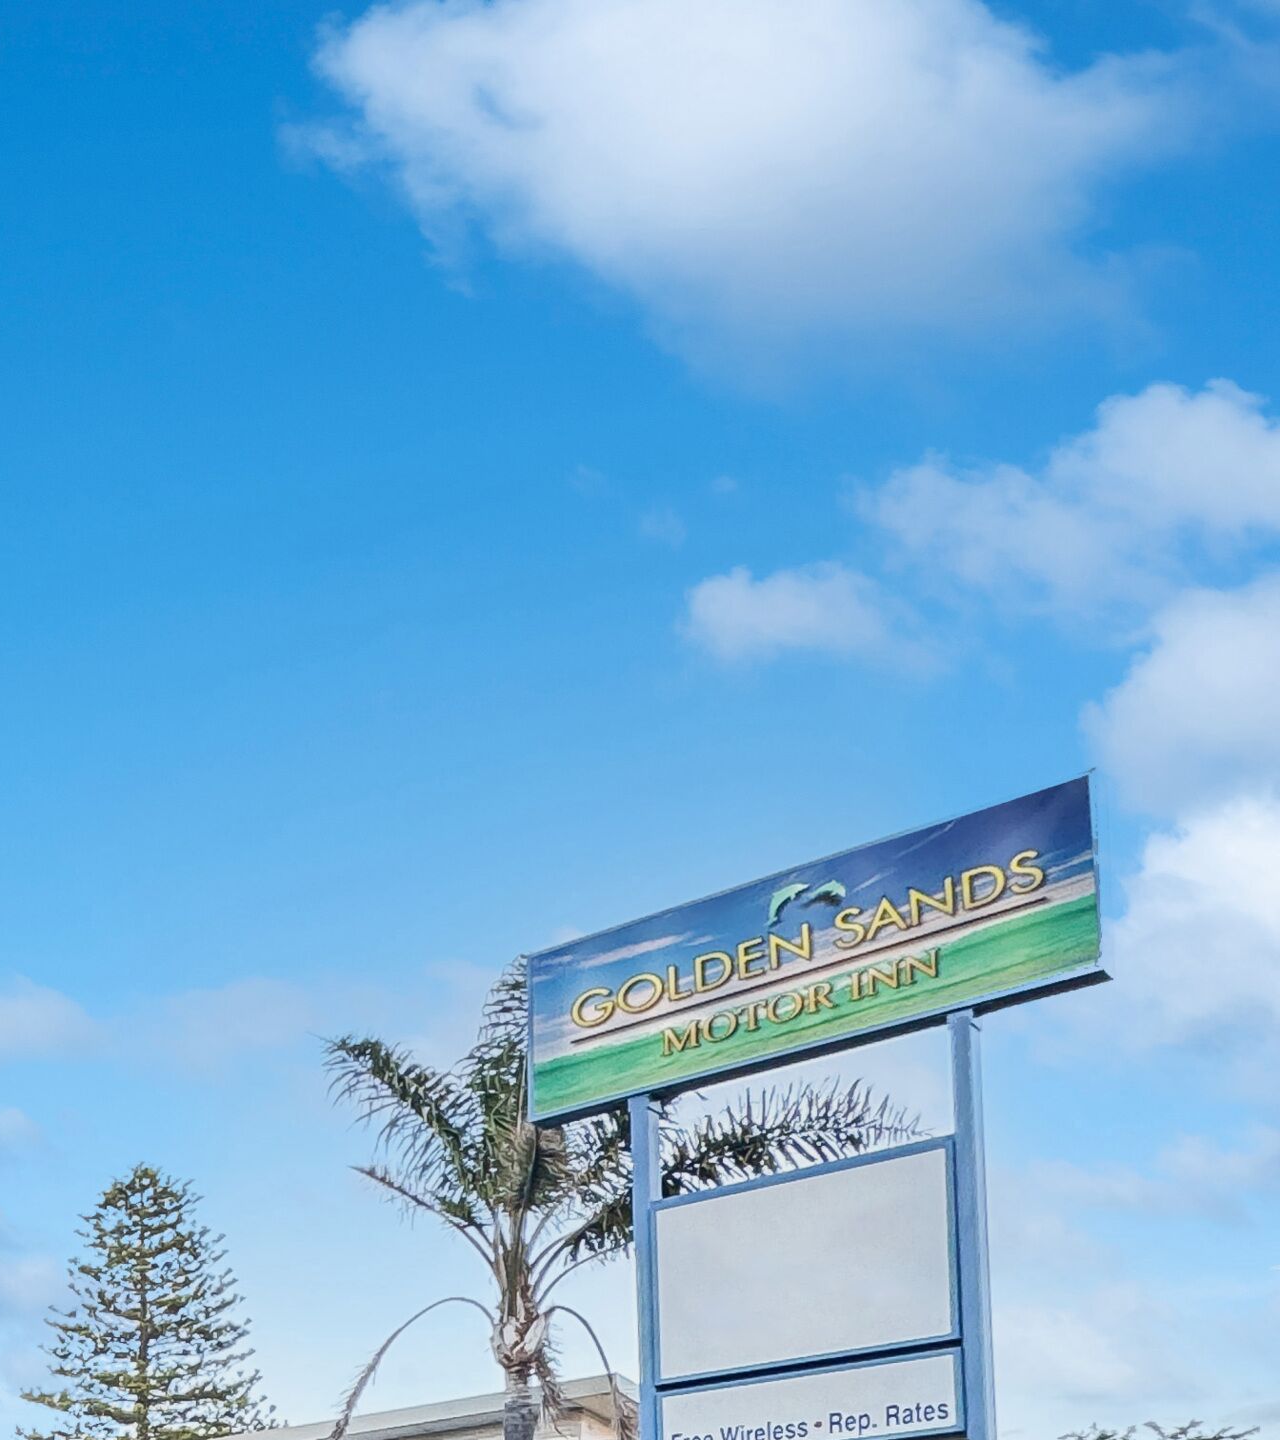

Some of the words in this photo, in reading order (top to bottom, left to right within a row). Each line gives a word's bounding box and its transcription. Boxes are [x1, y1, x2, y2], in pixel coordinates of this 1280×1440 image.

[572, 921, 812, 1028] GOLDEN
[834, 849, 1045, 949] SANDS
[661, 979, 835, 1056] MOTOR
[849, 947, 940, 1001] INN
[829, 1412, 878, 1436] Rep.
[885, 1402, 949, 1427] Rates
